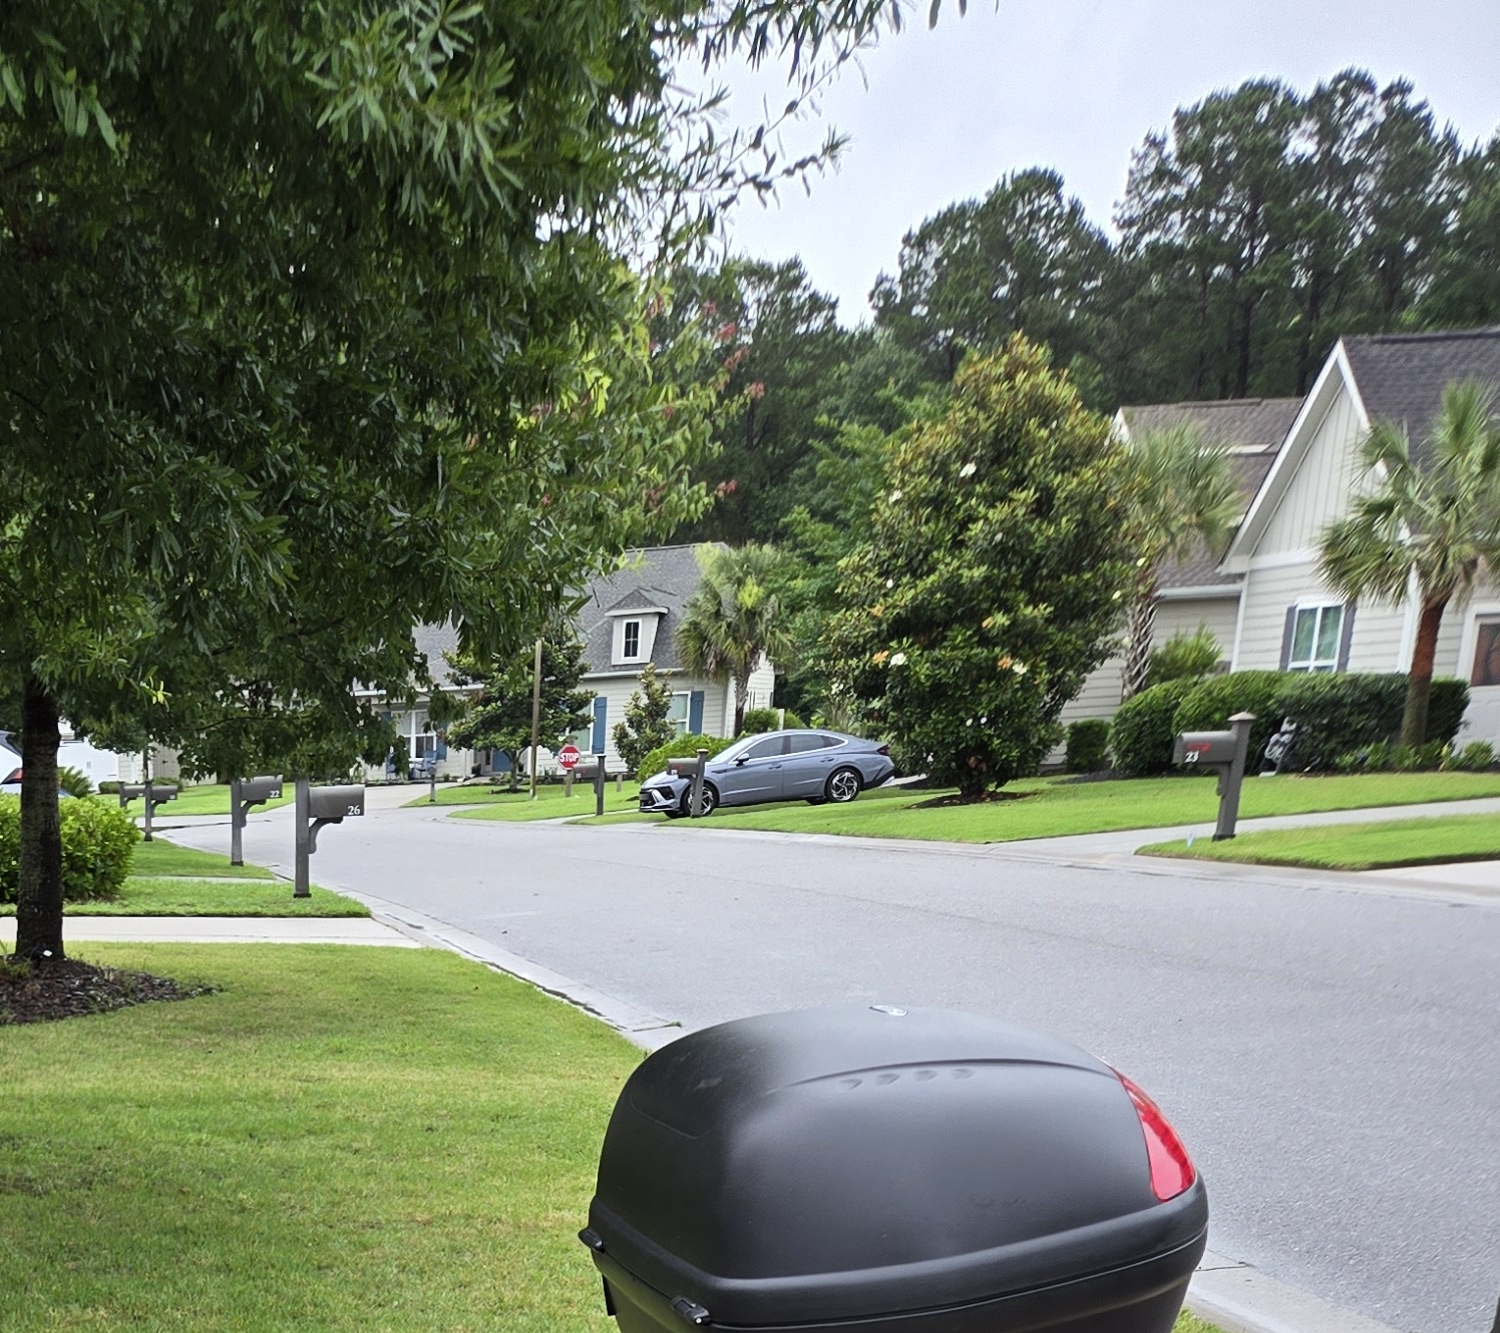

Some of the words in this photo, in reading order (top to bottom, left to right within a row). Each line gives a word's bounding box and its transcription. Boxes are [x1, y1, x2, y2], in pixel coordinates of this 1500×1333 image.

[560, 752, 579, 763] STOP
[269, 790, 280, 798] 22
[347, 805, 361, 816] 26
